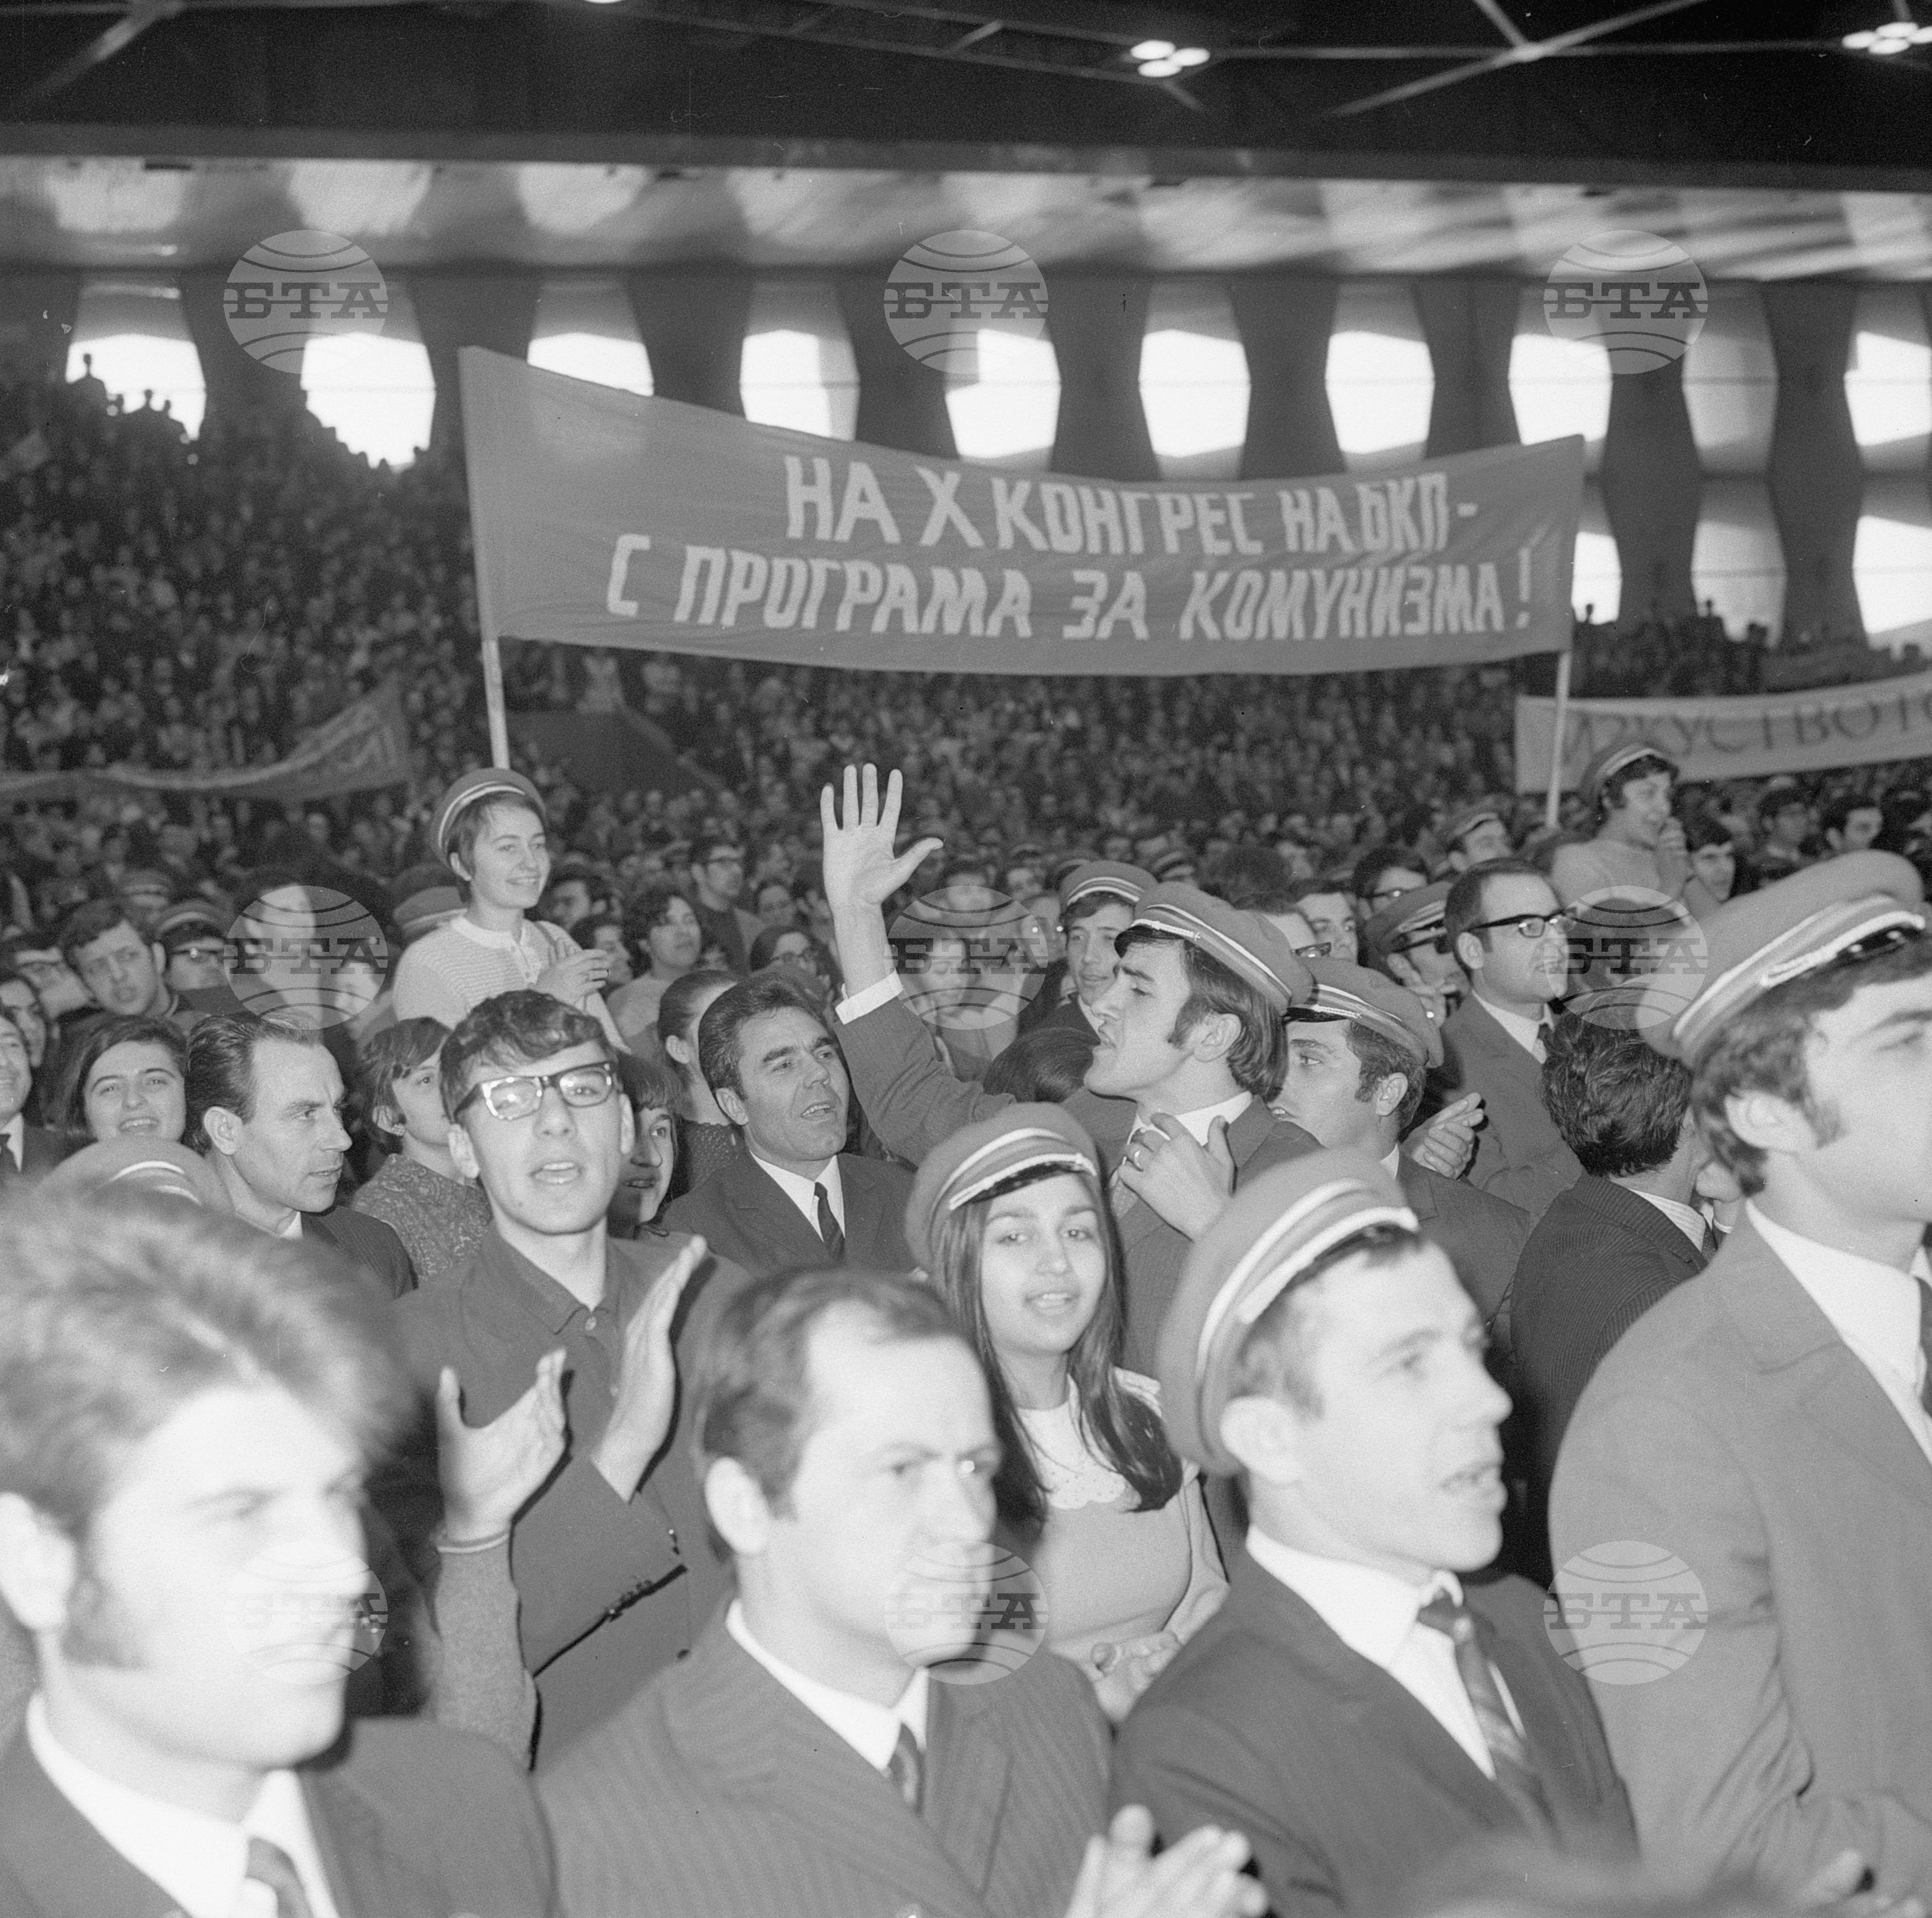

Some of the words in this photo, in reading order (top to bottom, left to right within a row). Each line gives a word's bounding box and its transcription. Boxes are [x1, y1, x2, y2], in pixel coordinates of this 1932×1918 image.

[783, 455, 901, 544] НА
[912, 464, 985, 548] Х
[990, 477, 1264, 556] КОНГРЕС
[1278, 487, 1354, 554] НА
[606, 533, 651, 617] С
[673, 545, 1032, 638] ПРОГРАМА
[1062, 569, 1150, 641] ЗА
